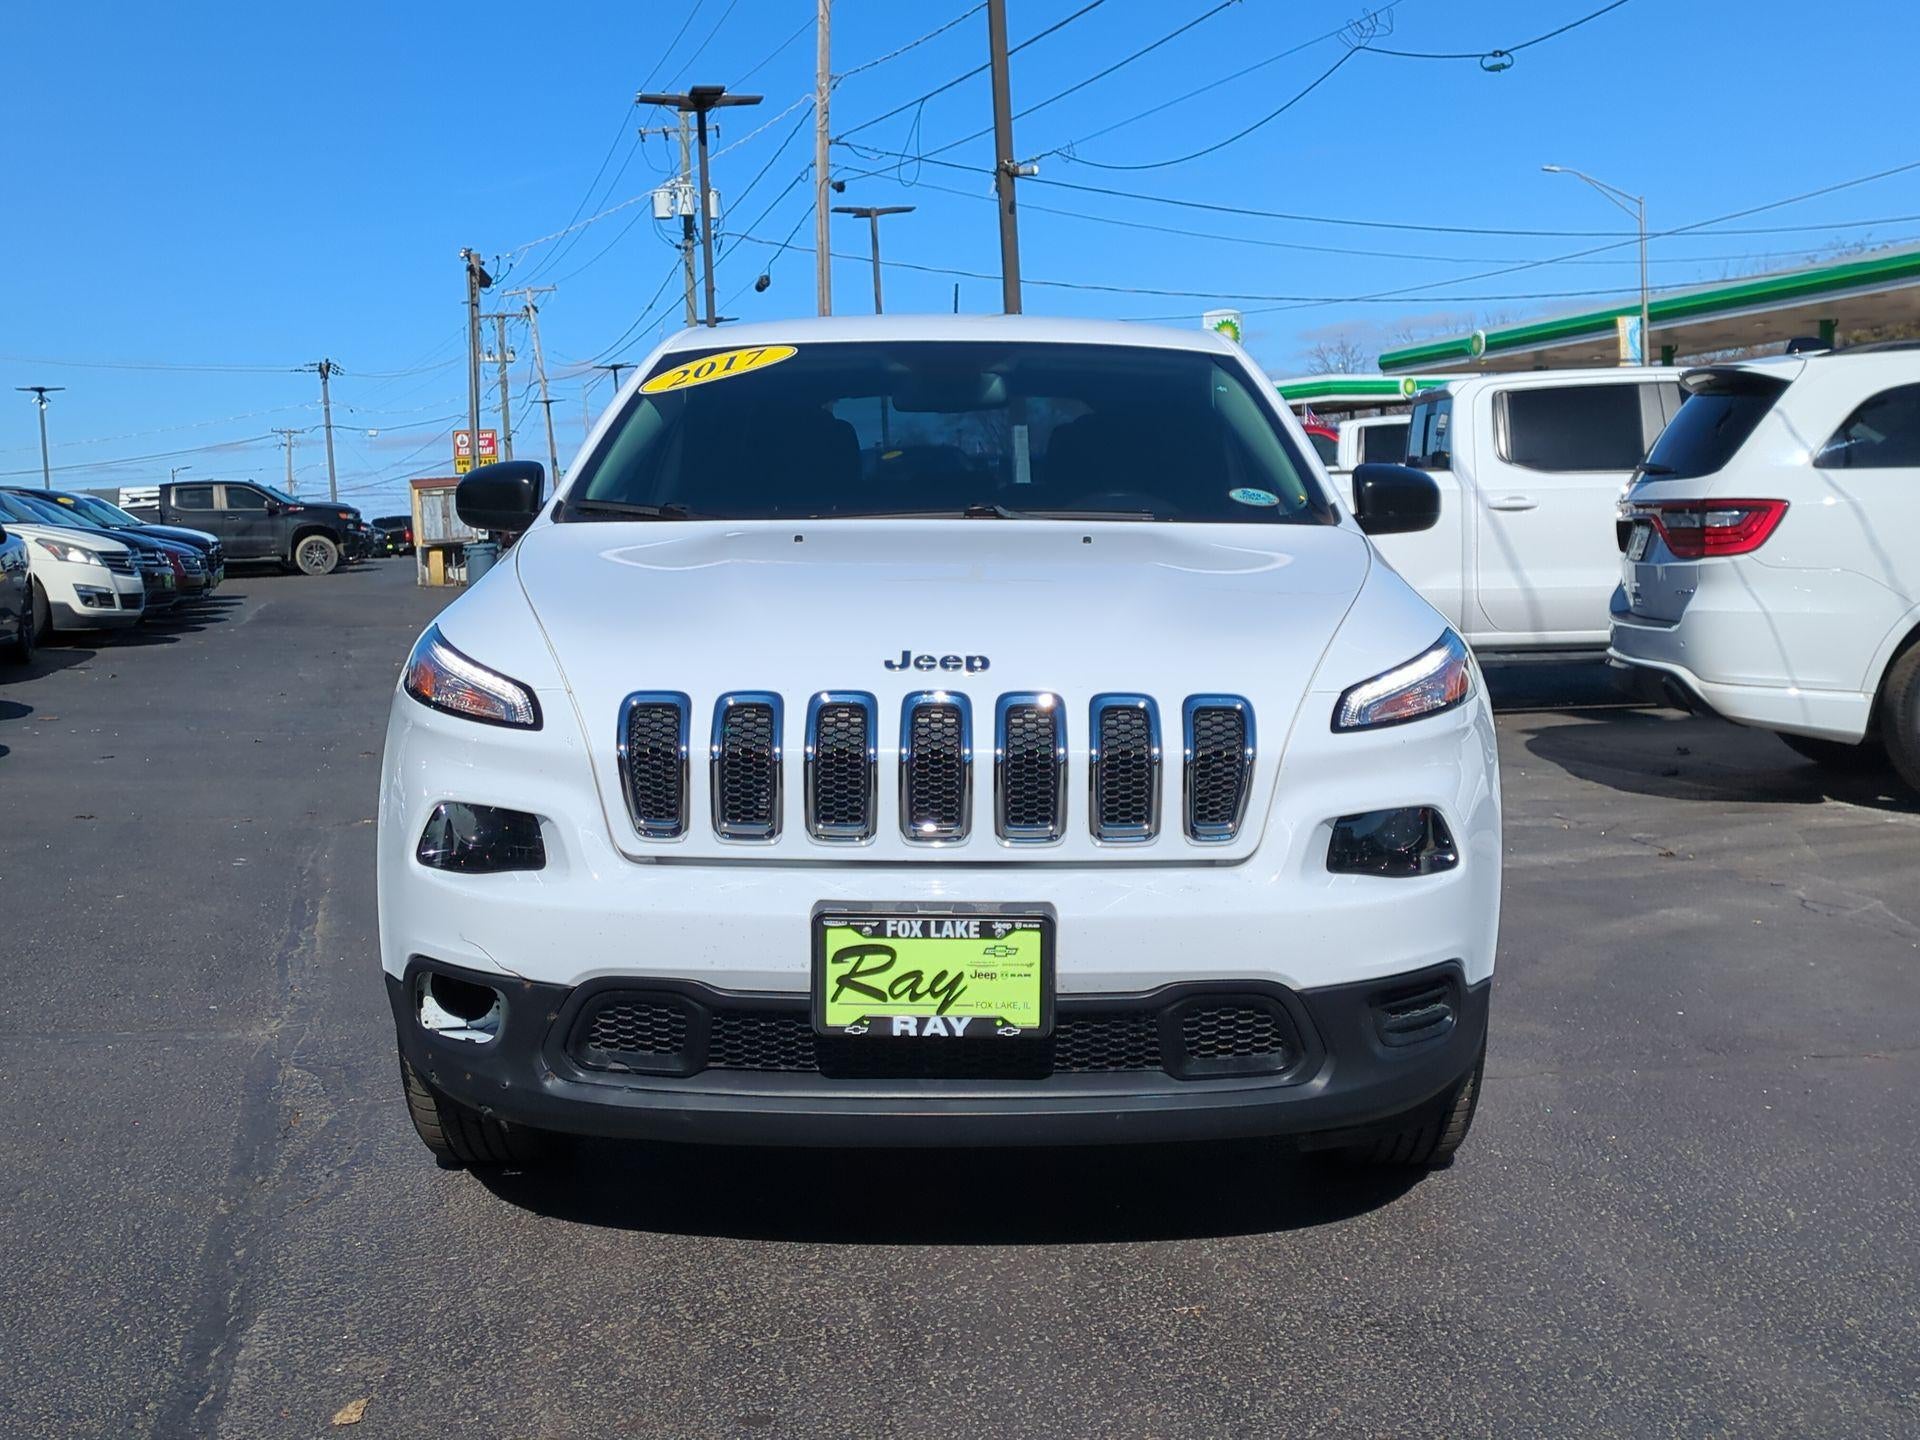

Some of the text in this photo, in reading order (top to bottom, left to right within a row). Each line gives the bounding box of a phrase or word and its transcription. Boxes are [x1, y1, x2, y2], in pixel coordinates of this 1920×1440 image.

[667, 349, 767, 389] 2017
[884, 650, 991, 674] Jeep
[886, 920, 981, 938] FOX LAKE
[831, 944, 968, 1016] Ray
[970, 969, 997, 980] Jeep
[975, 1001, 993, 1010] FOX
[1023, 1001, 1031, 1010] IL
[893, 1016, 972, 1036] RAY
